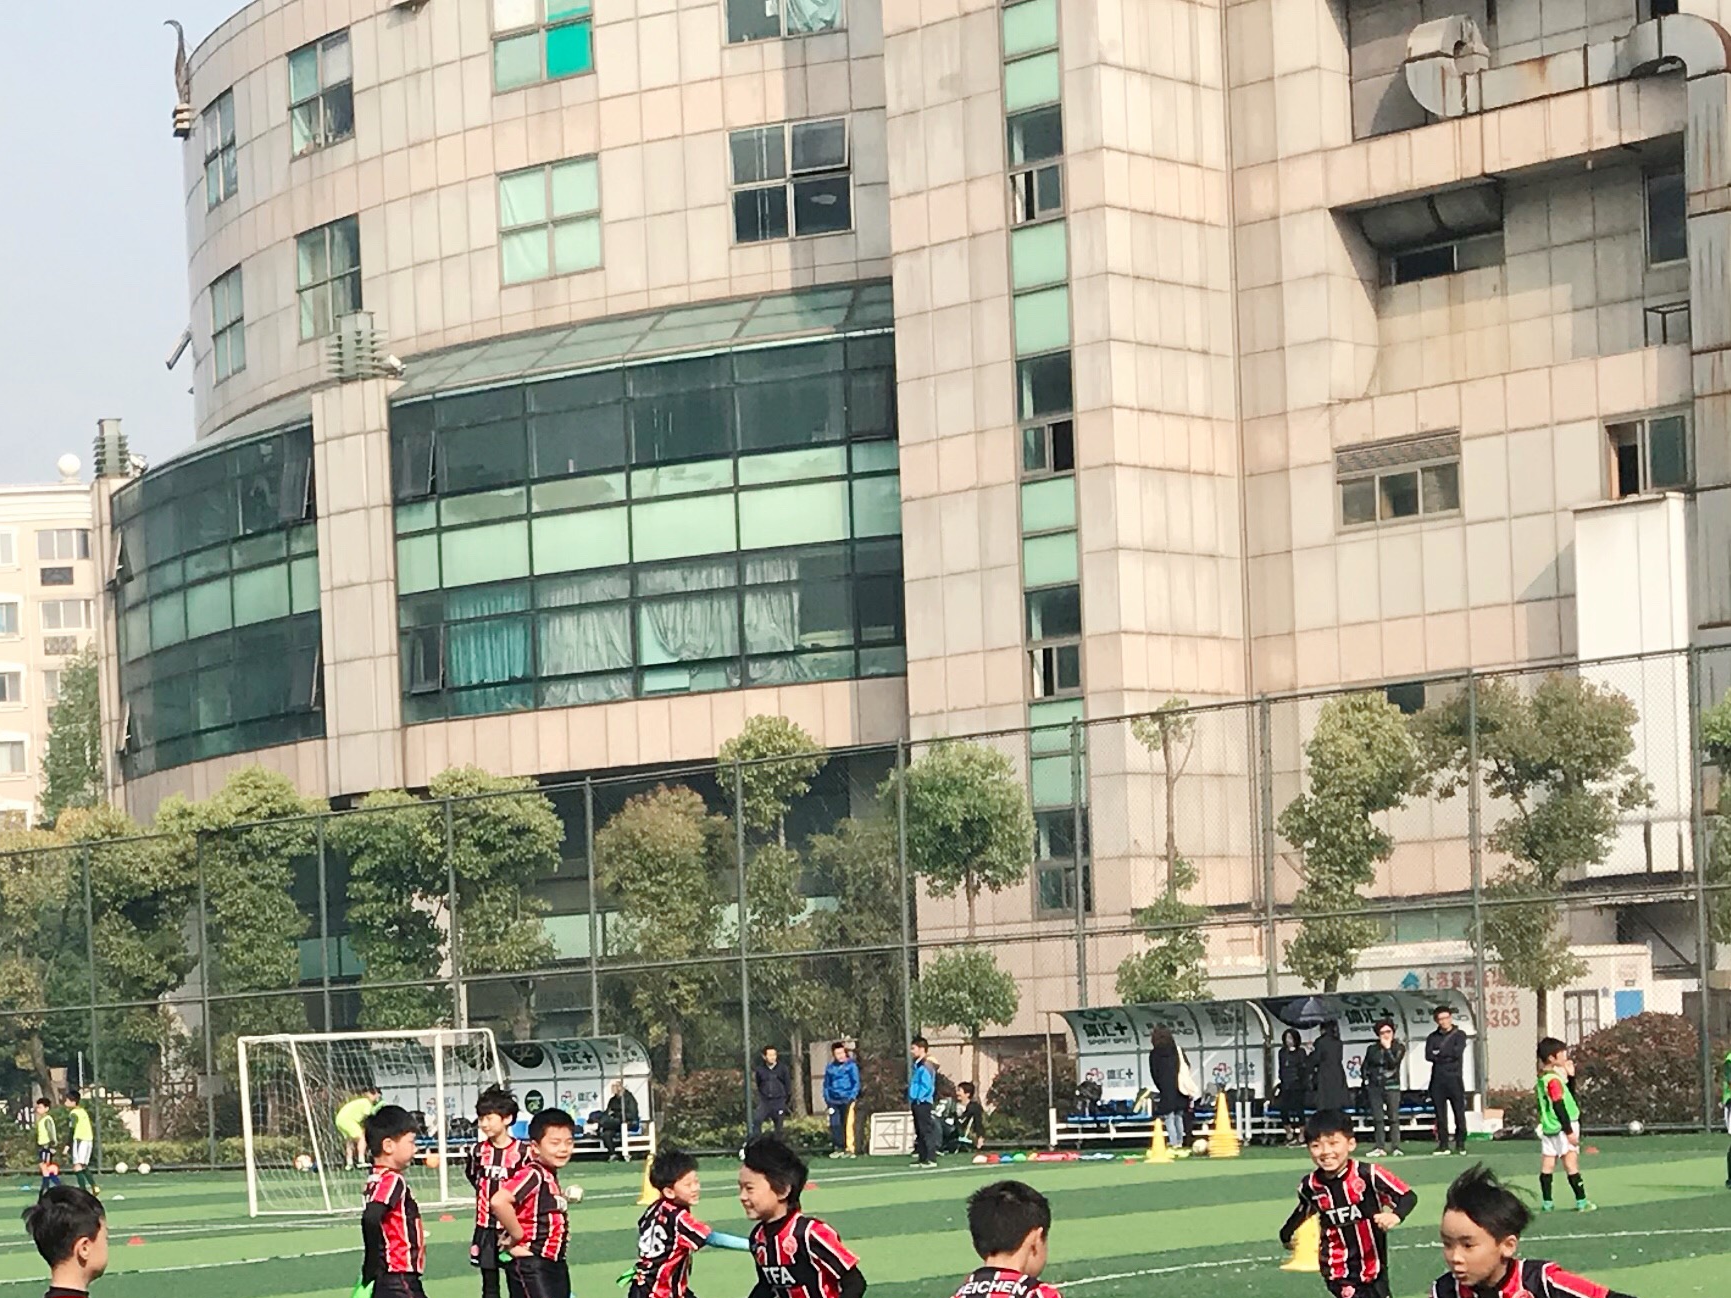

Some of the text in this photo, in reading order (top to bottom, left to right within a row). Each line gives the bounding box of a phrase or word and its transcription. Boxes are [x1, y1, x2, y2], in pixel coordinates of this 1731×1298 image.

[484, 1165, 508, 1179] TFA
[1326, 1204, 1363, 1224] TFA
[762, 1265, 797, 1286] TFA
